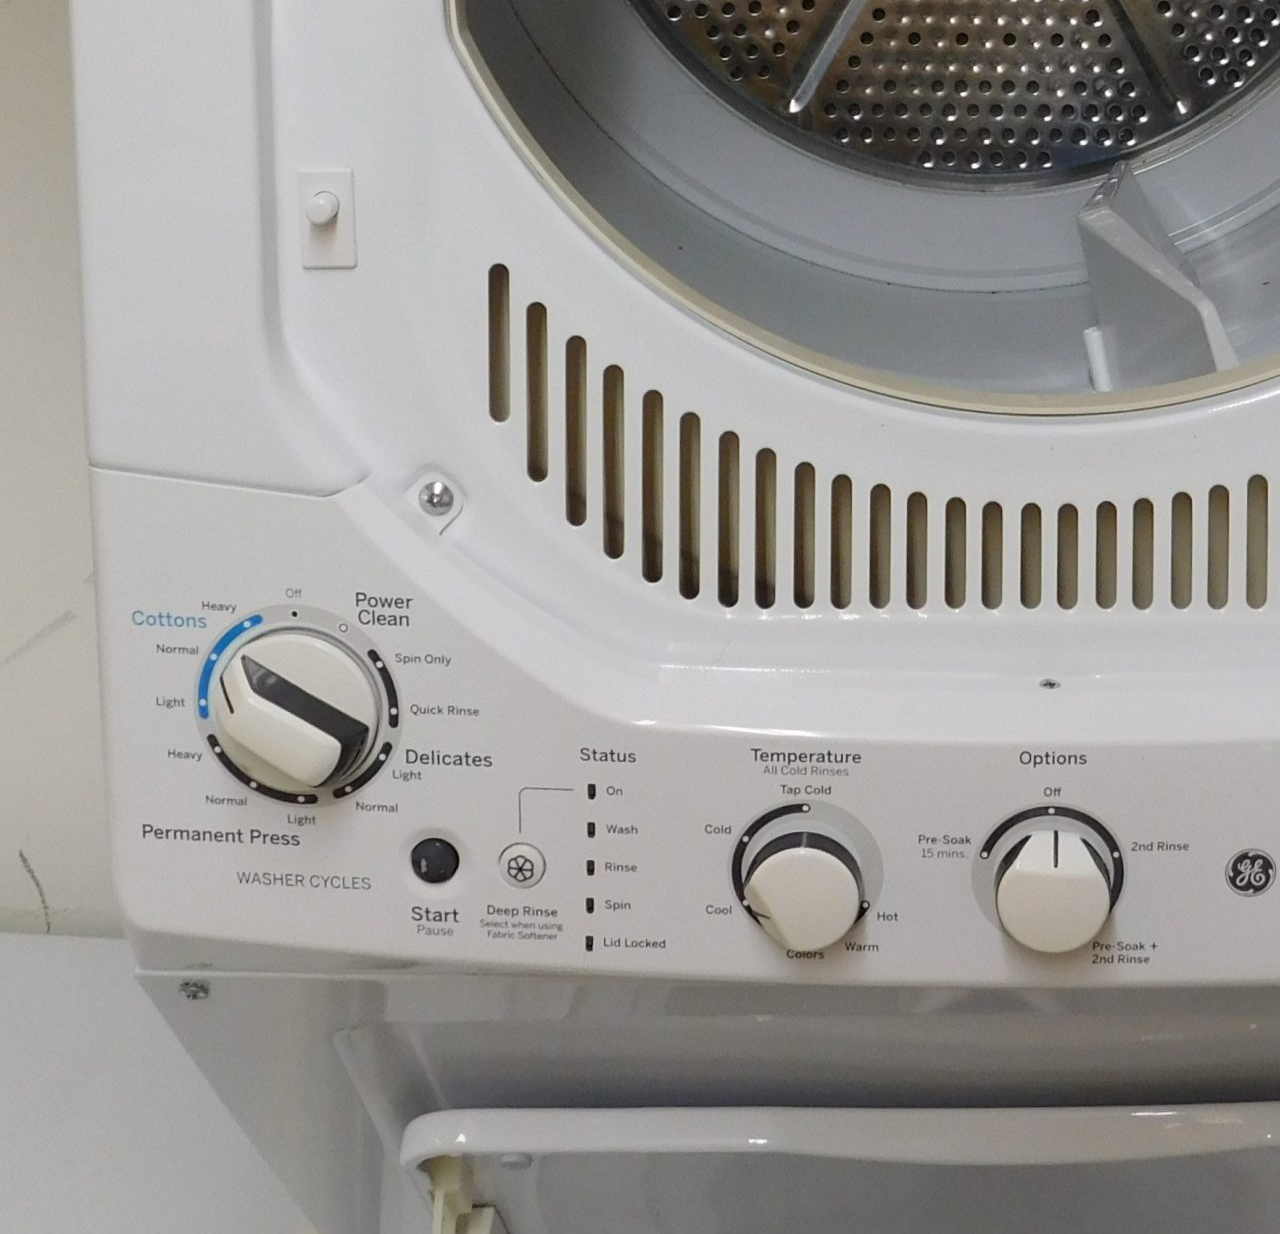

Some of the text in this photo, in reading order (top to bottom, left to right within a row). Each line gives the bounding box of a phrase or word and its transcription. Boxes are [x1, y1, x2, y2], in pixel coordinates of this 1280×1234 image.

[285, 588, 302, 598] Off
[356, 592, 413, 609] Power
[202, 601, 237, 614] Heavy
[132, 610, 207, 628] Cottons
[358, 609, 409, 626] Clean
[156, 644, 199, 655] Normal
[395, 653, 451, 667] Spin Only
[156, 697, 185, 709] Light
[410, 704, 479, 716] Quick Rinse
[168, 749, 202, 762] Heavy
[406, 749, 492, 767] Delicates
[580, 748, 636, 763] Status
[751, 748, 861, 765] Temperature
[1020, 751, 1087, 768] Options
[392, 769, 421, 782] Light
[763, 765, 849, 776] All Cold Rinses
[606, 786, 623, 796] On
[780, 784, 831, 796] Tap Cold
[1044, 787, 1061, 797] Off
[206, 795, 247, 806] Normal
[356, 801, 398, 812] Normal
[287, 814, 316, 826] Light
[606, 824, 638, 834] Wash
[705, 824, 731, 834] Cold
[142, 824, 300, 846] Permanent Press
[918, 834, 971, 844] Pre-Soak
[1131, 842, 1189, 851] 2nd Rinse
[922, 848, 934, 858] 15
[605, 862, 637, 872] Rinse
[237, 872, 371, 890] WASHER CYCLES
[605, 900, 631, 911] Spin
[706, 905, 732, 915] Cool
[412, 906, 459, 923] Start
[487, 905, 557, 918] Deep Rinse
[877, 912, 898, 921] Hot
[417, 924, 454, 936] Pause
[480, 919, 563, 932] Select when using
[487, 930, 557, 940] Fabric Softener
[604, 937, 666, 948] Lid Locked
[845, 942, 879, 951] Warm
[1092, 941, 1158, 952] Pre-Soak +
[786, 949, 825, 960] Colors
[1092, 953, 1150, 964] 2nd Rinse
